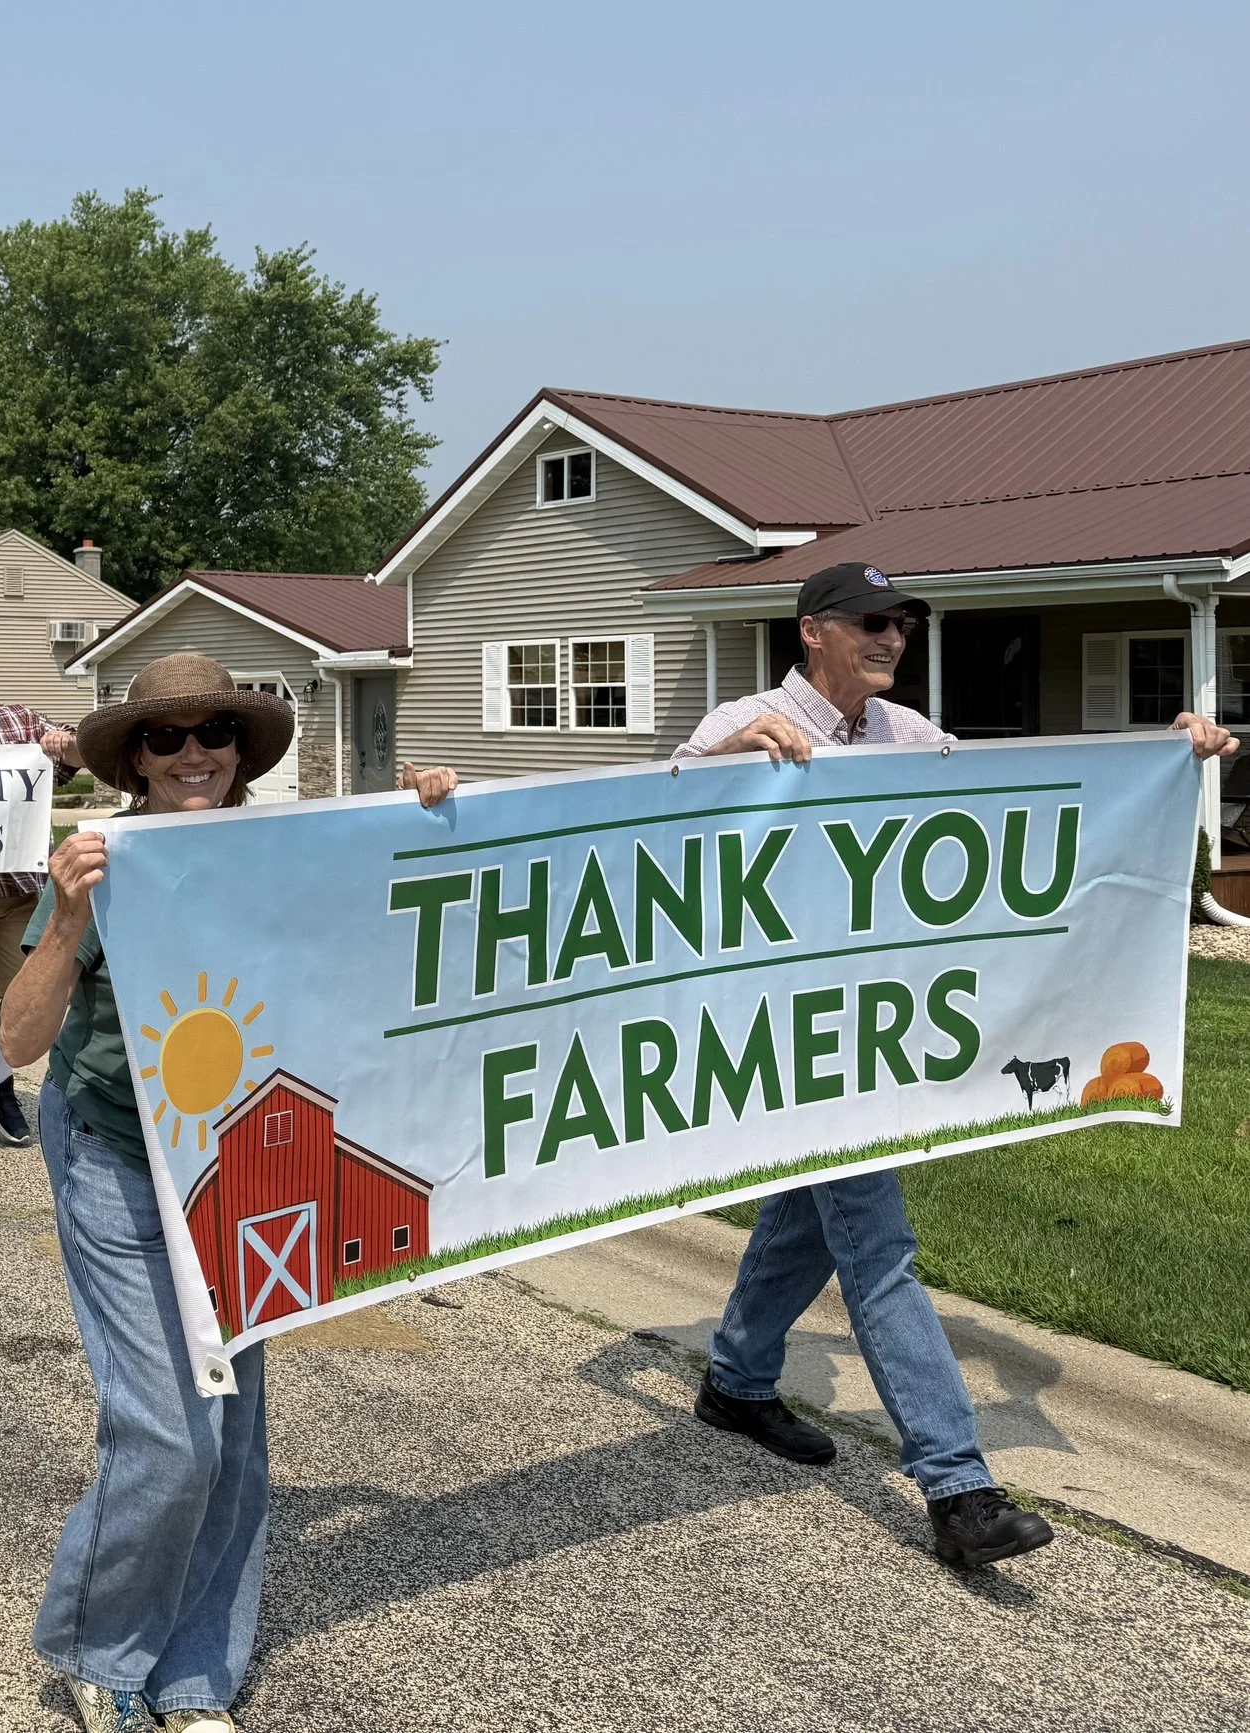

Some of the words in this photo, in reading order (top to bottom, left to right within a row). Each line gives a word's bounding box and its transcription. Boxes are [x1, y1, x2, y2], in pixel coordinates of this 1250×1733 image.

[387, 824, 798, 1011] THANK
[819, 804, 1084, 935] YOU
[480, 966, 981, 1180] FARMERS
